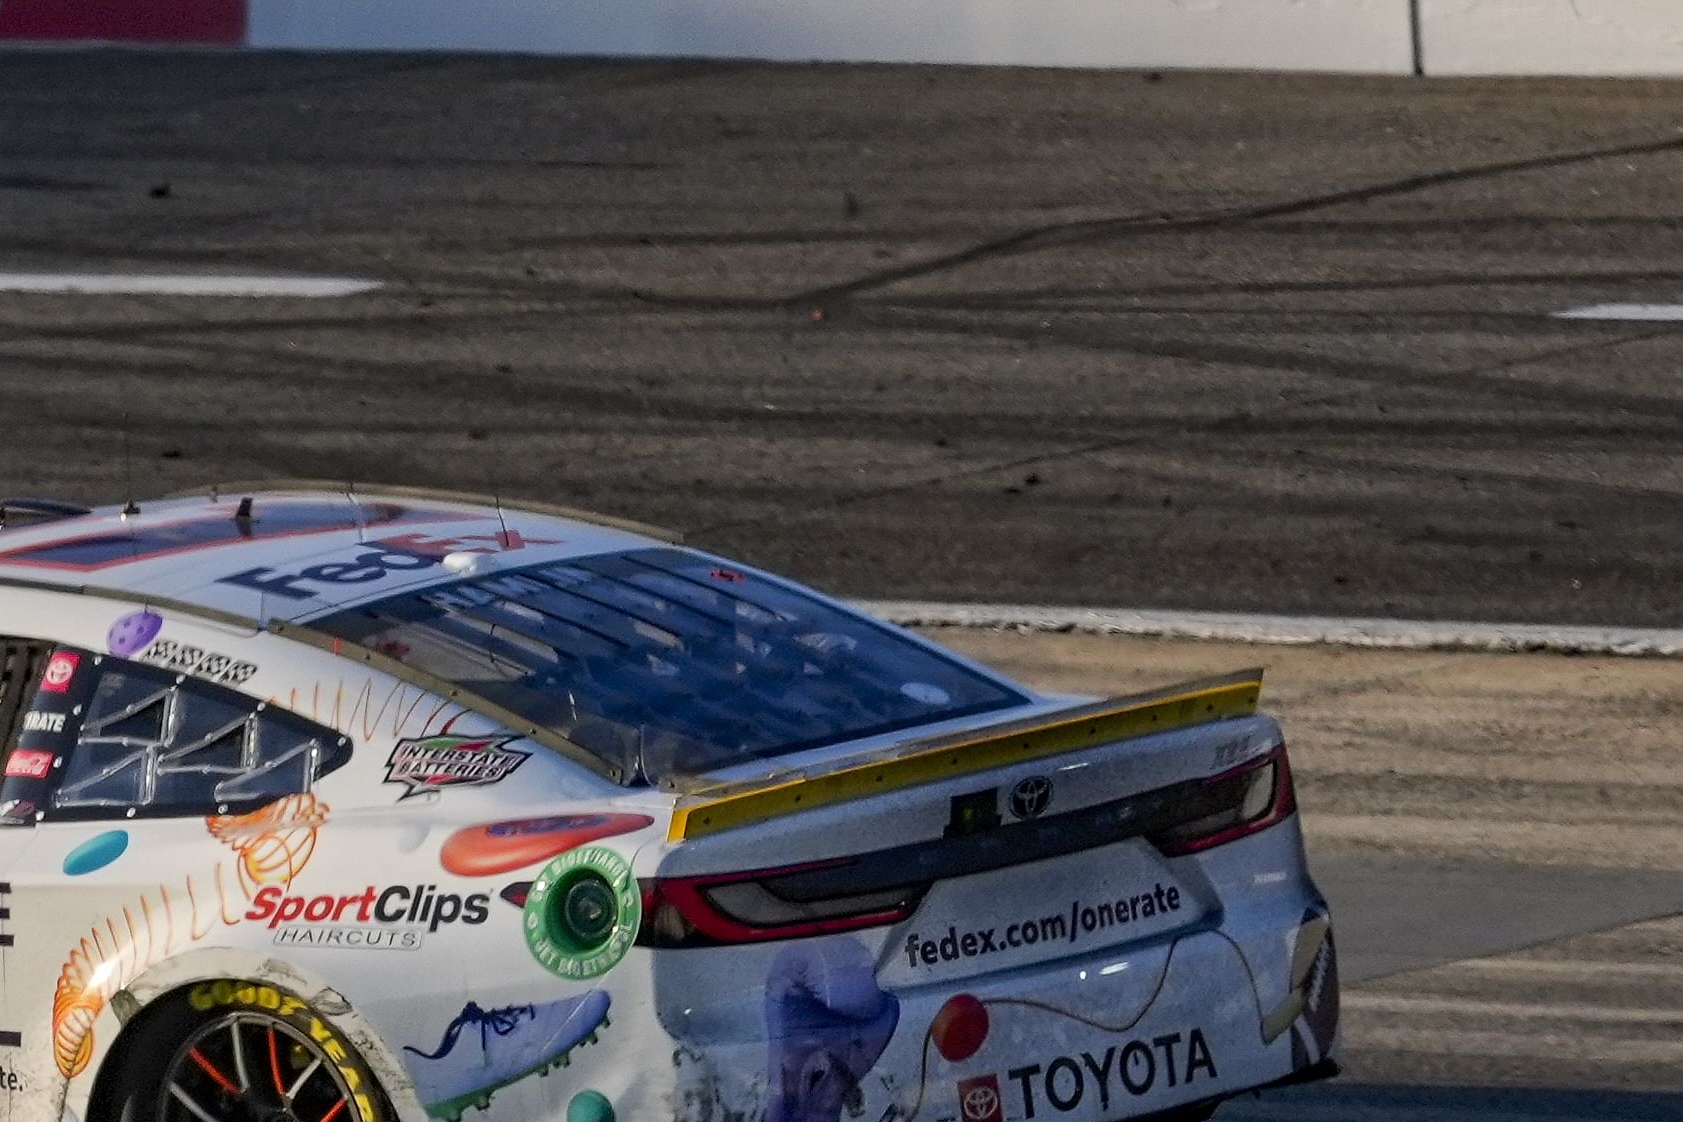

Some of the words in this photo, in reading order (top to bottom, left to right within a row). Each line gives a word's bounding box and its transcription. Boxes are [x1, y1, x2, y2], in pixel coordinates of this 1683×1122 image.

[401, 743, 516, 767] INTERSTATE
[400, 761, 506, 778] BATTERIES
[905, 881, 1181, 968] fedex.com/onerate
[280, 930, 416, 947] HAIRCUTS
[1009, 1029, 1217, 1119] TOYOTA
